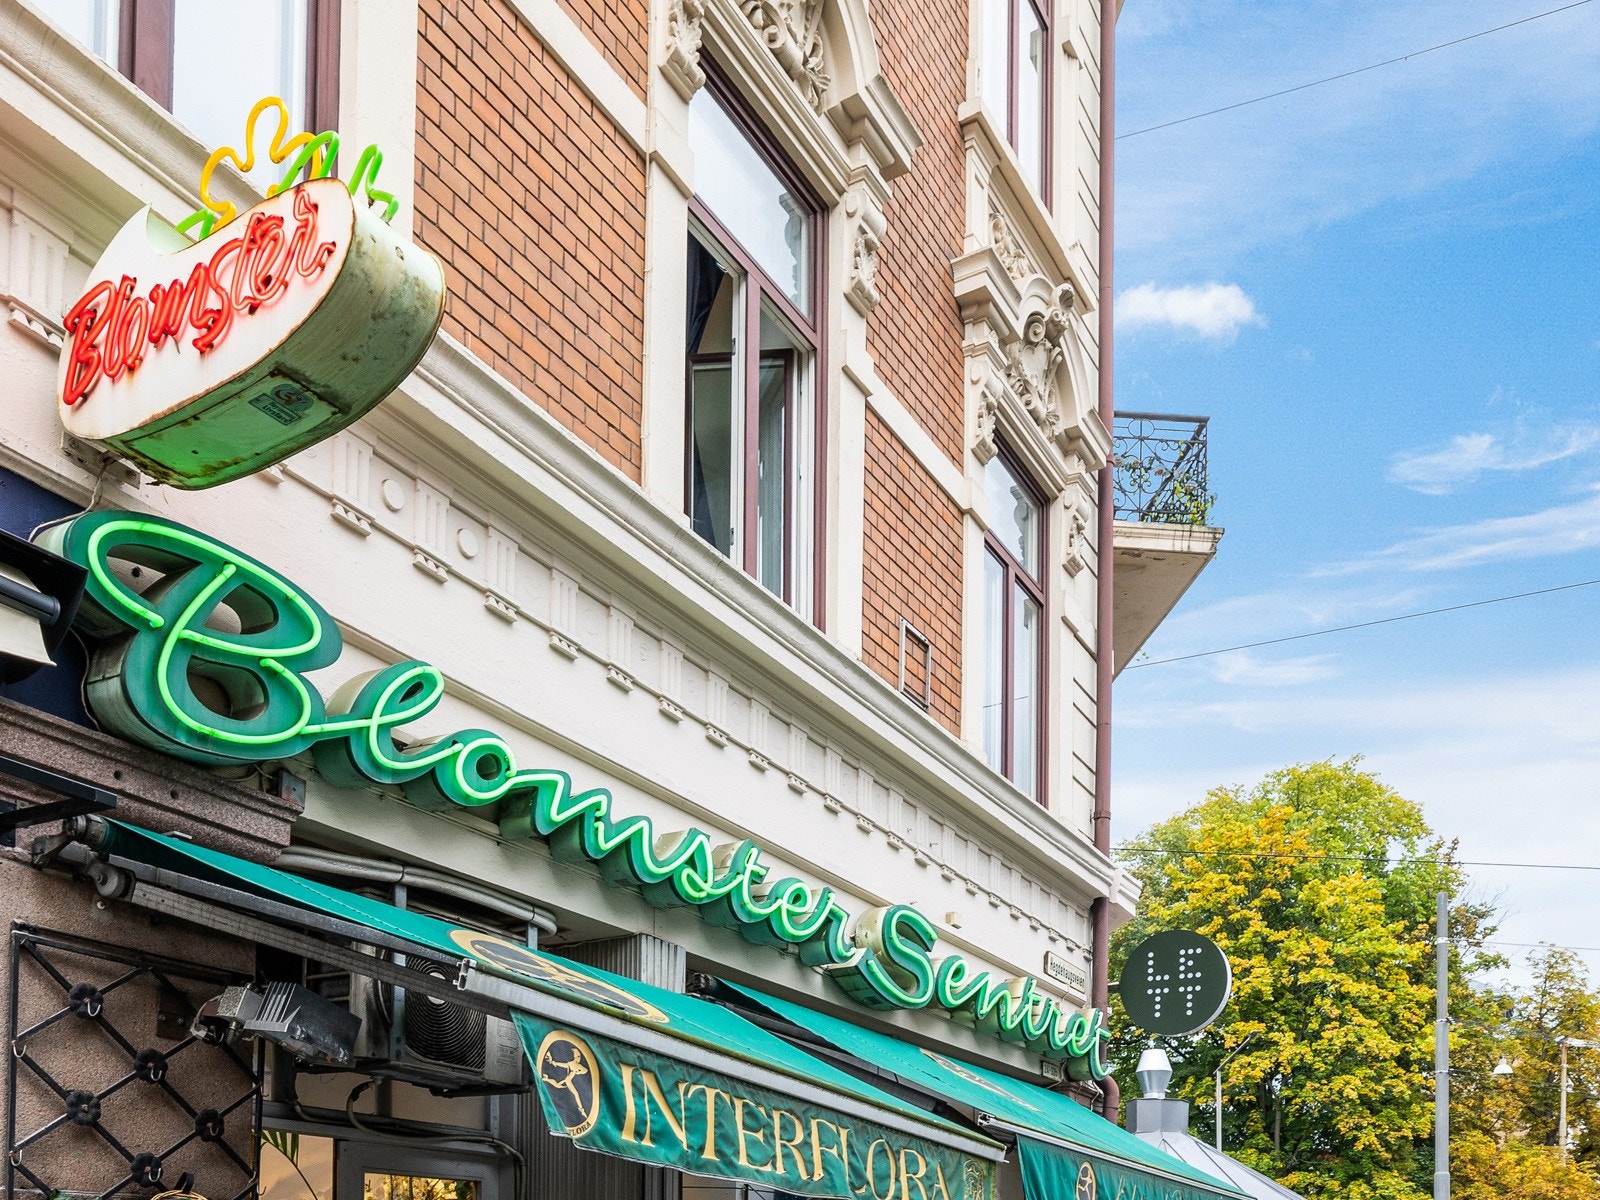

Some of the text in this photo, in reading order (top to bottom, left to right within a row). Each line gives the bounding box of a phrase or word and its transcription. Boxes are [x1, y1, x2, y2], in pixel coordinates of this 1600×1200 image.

[63, 188, 337, 406] Blomster
[70, 511, 1113, 1081] Blomster Sentret
[570, 1121, 591, 1136] LORA
